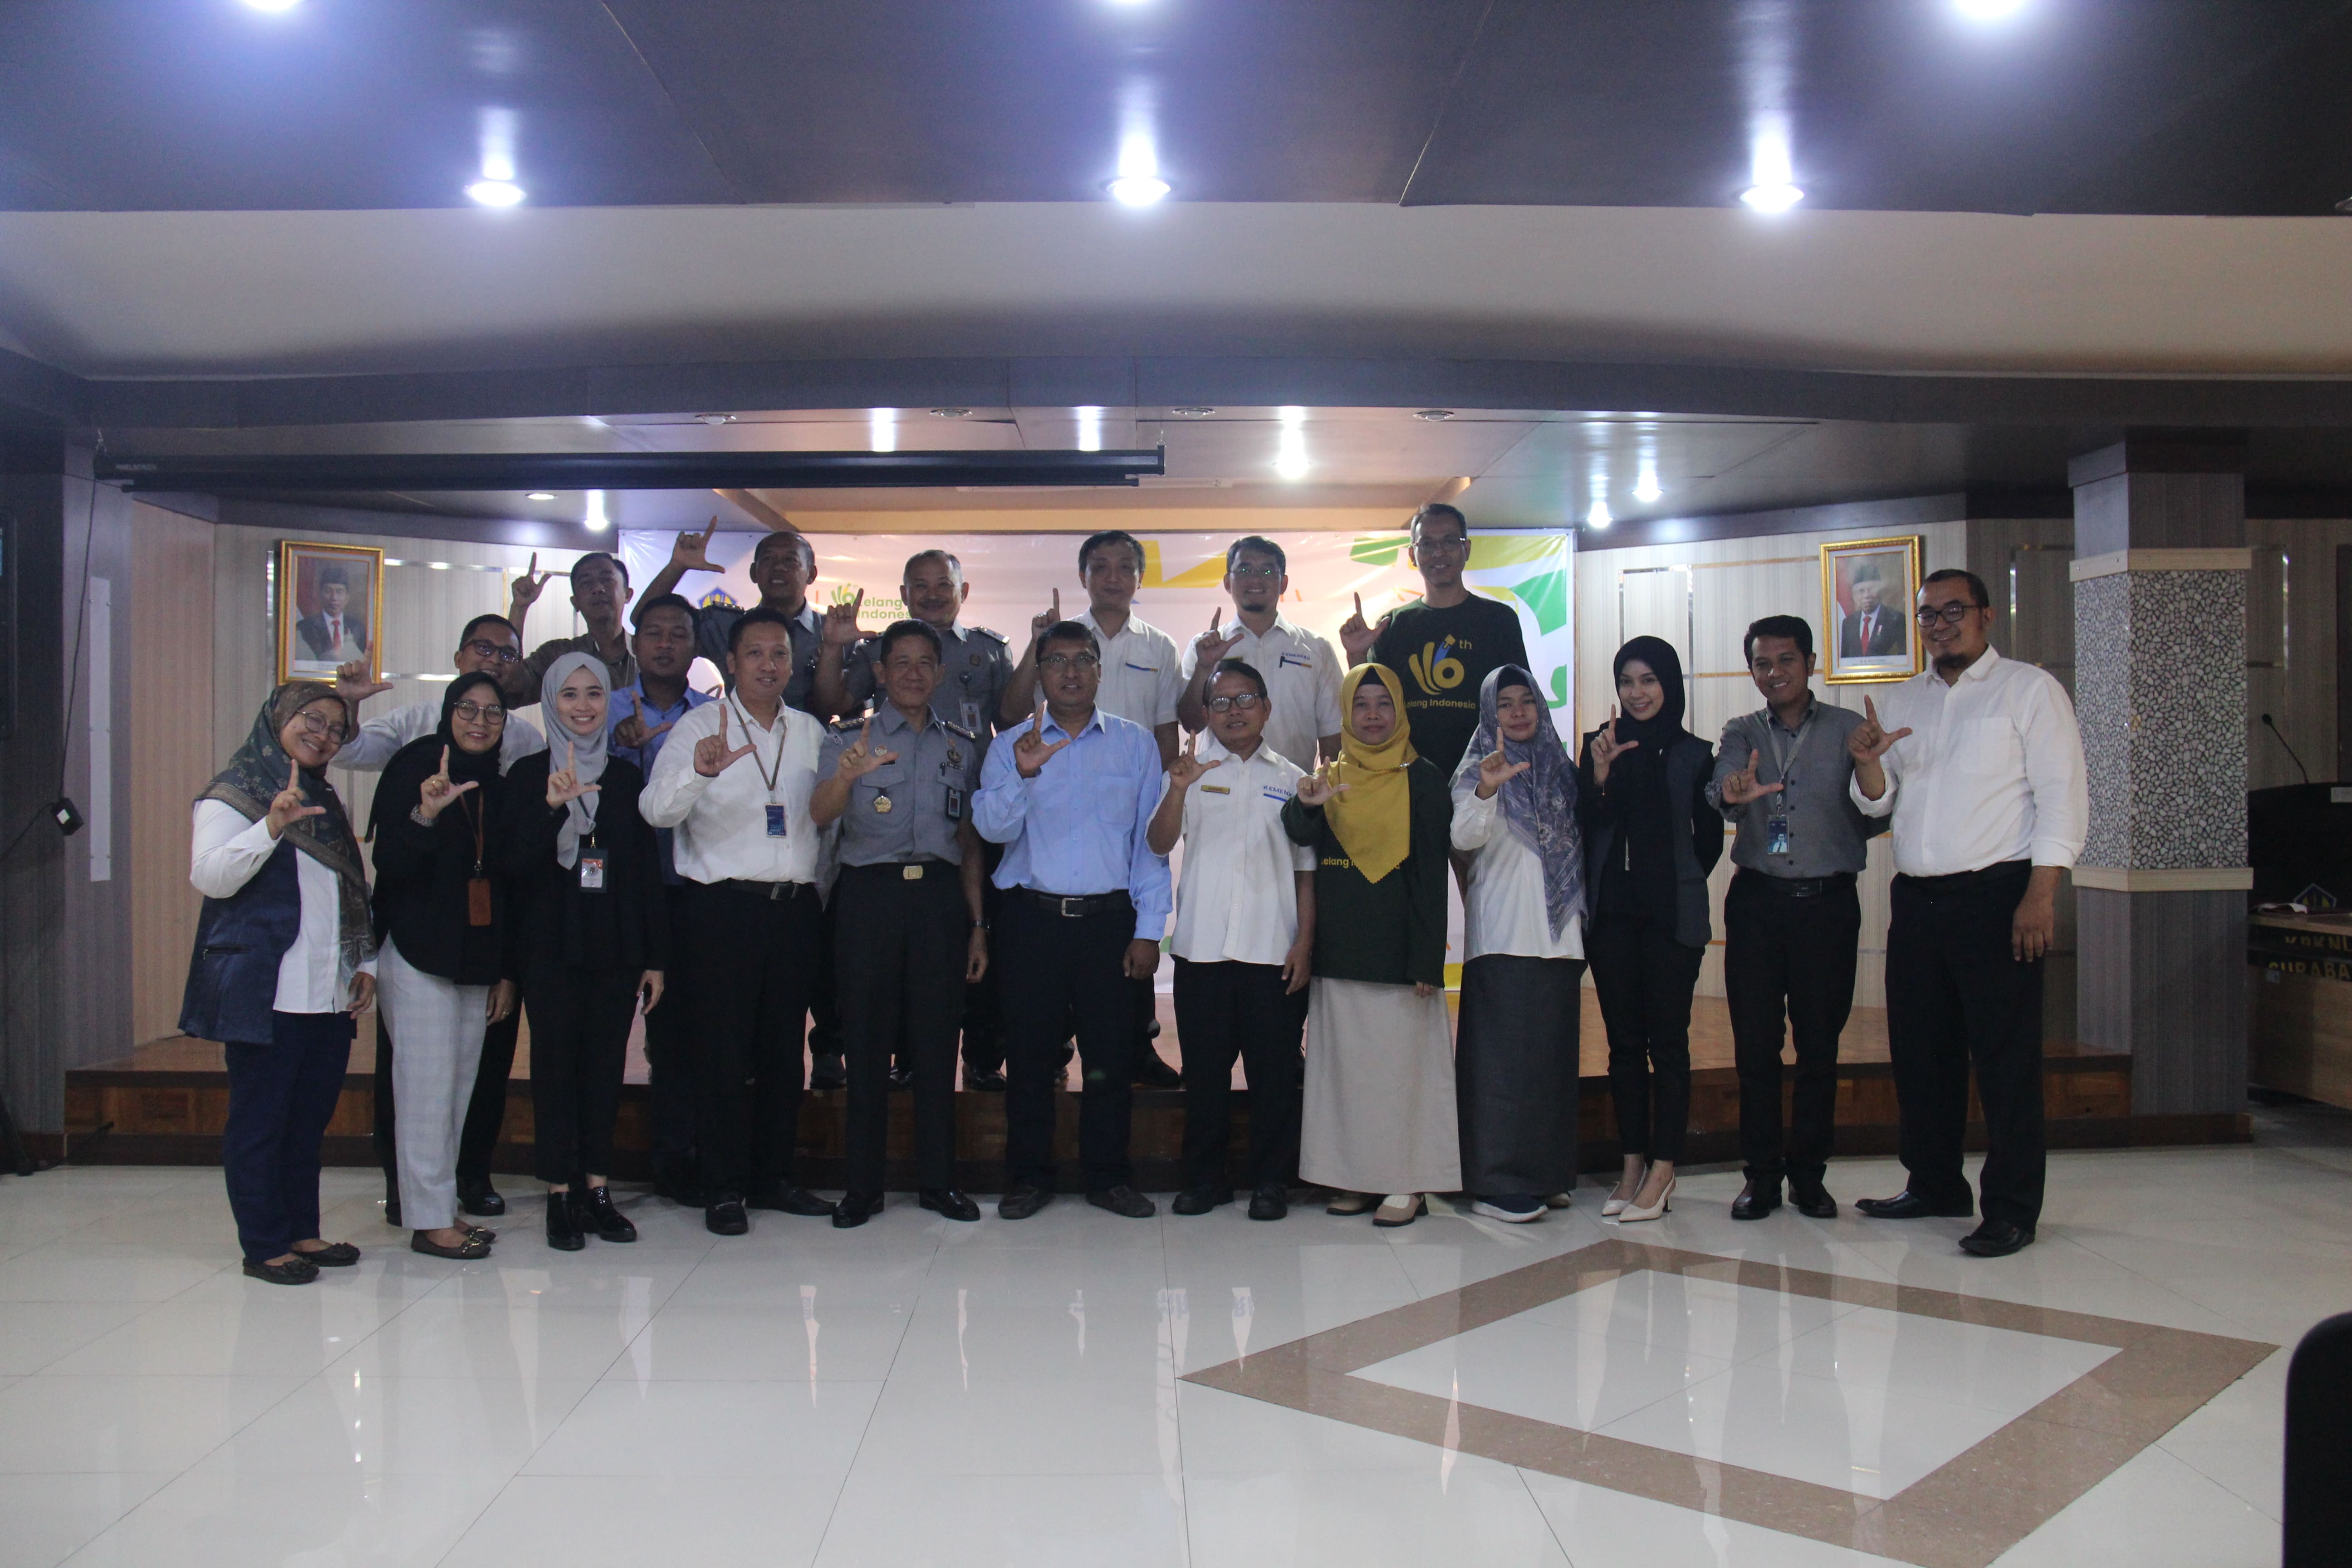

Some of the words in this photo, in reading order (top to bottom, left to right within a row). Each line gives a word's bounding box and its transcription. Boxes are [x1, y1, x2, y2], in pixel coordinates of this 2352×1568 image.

[860, 597, 902, 610] elang
[1429, 699, 1476, 710] Indonesia
[1322, 857, 1349, 869] elang
